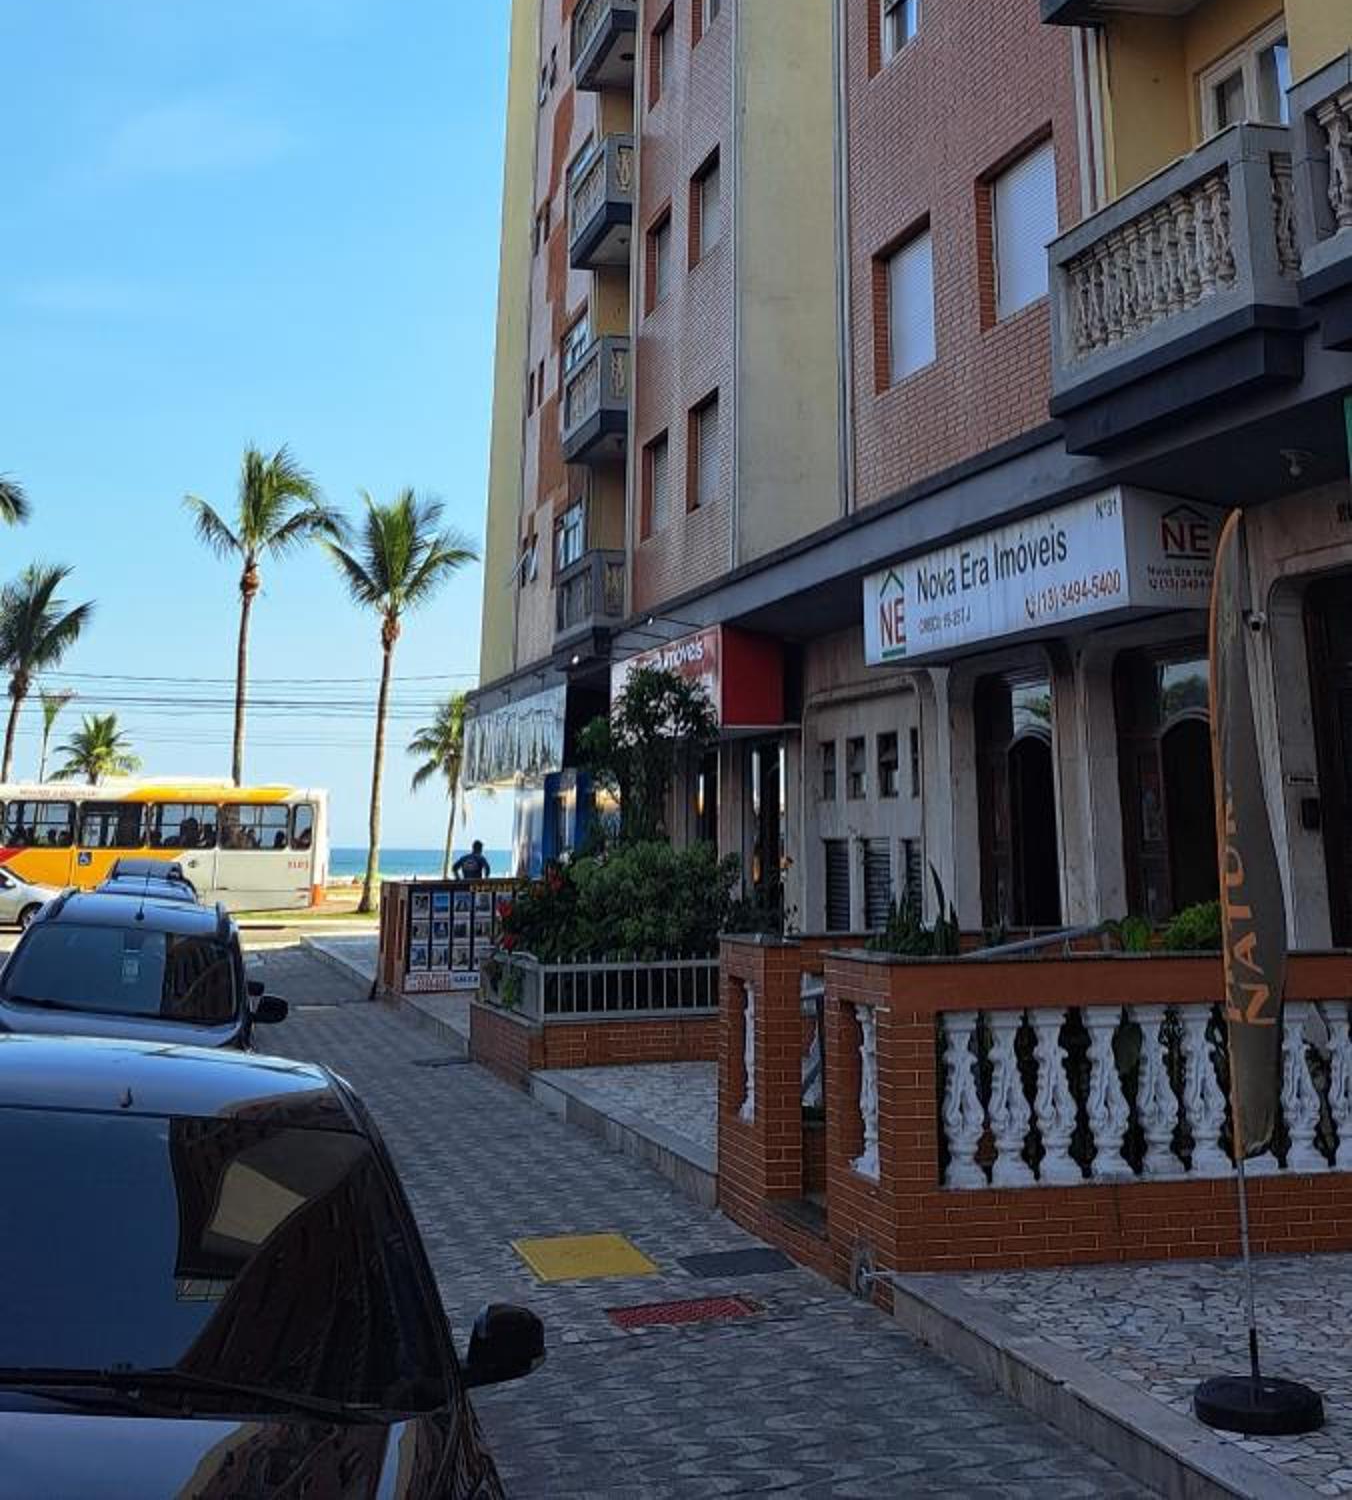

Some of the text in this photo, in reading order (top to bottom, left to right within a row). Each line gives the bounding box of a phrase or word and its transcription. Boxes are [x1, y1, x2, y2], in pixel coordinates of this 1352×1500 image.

[1160, 517, 1210, 553] NE
[917, 523, 1067, 605] Nova Era Imóveis
[1060, 568, 1121, 608] 3494-5400
[880, 597, 907, 648] NE
